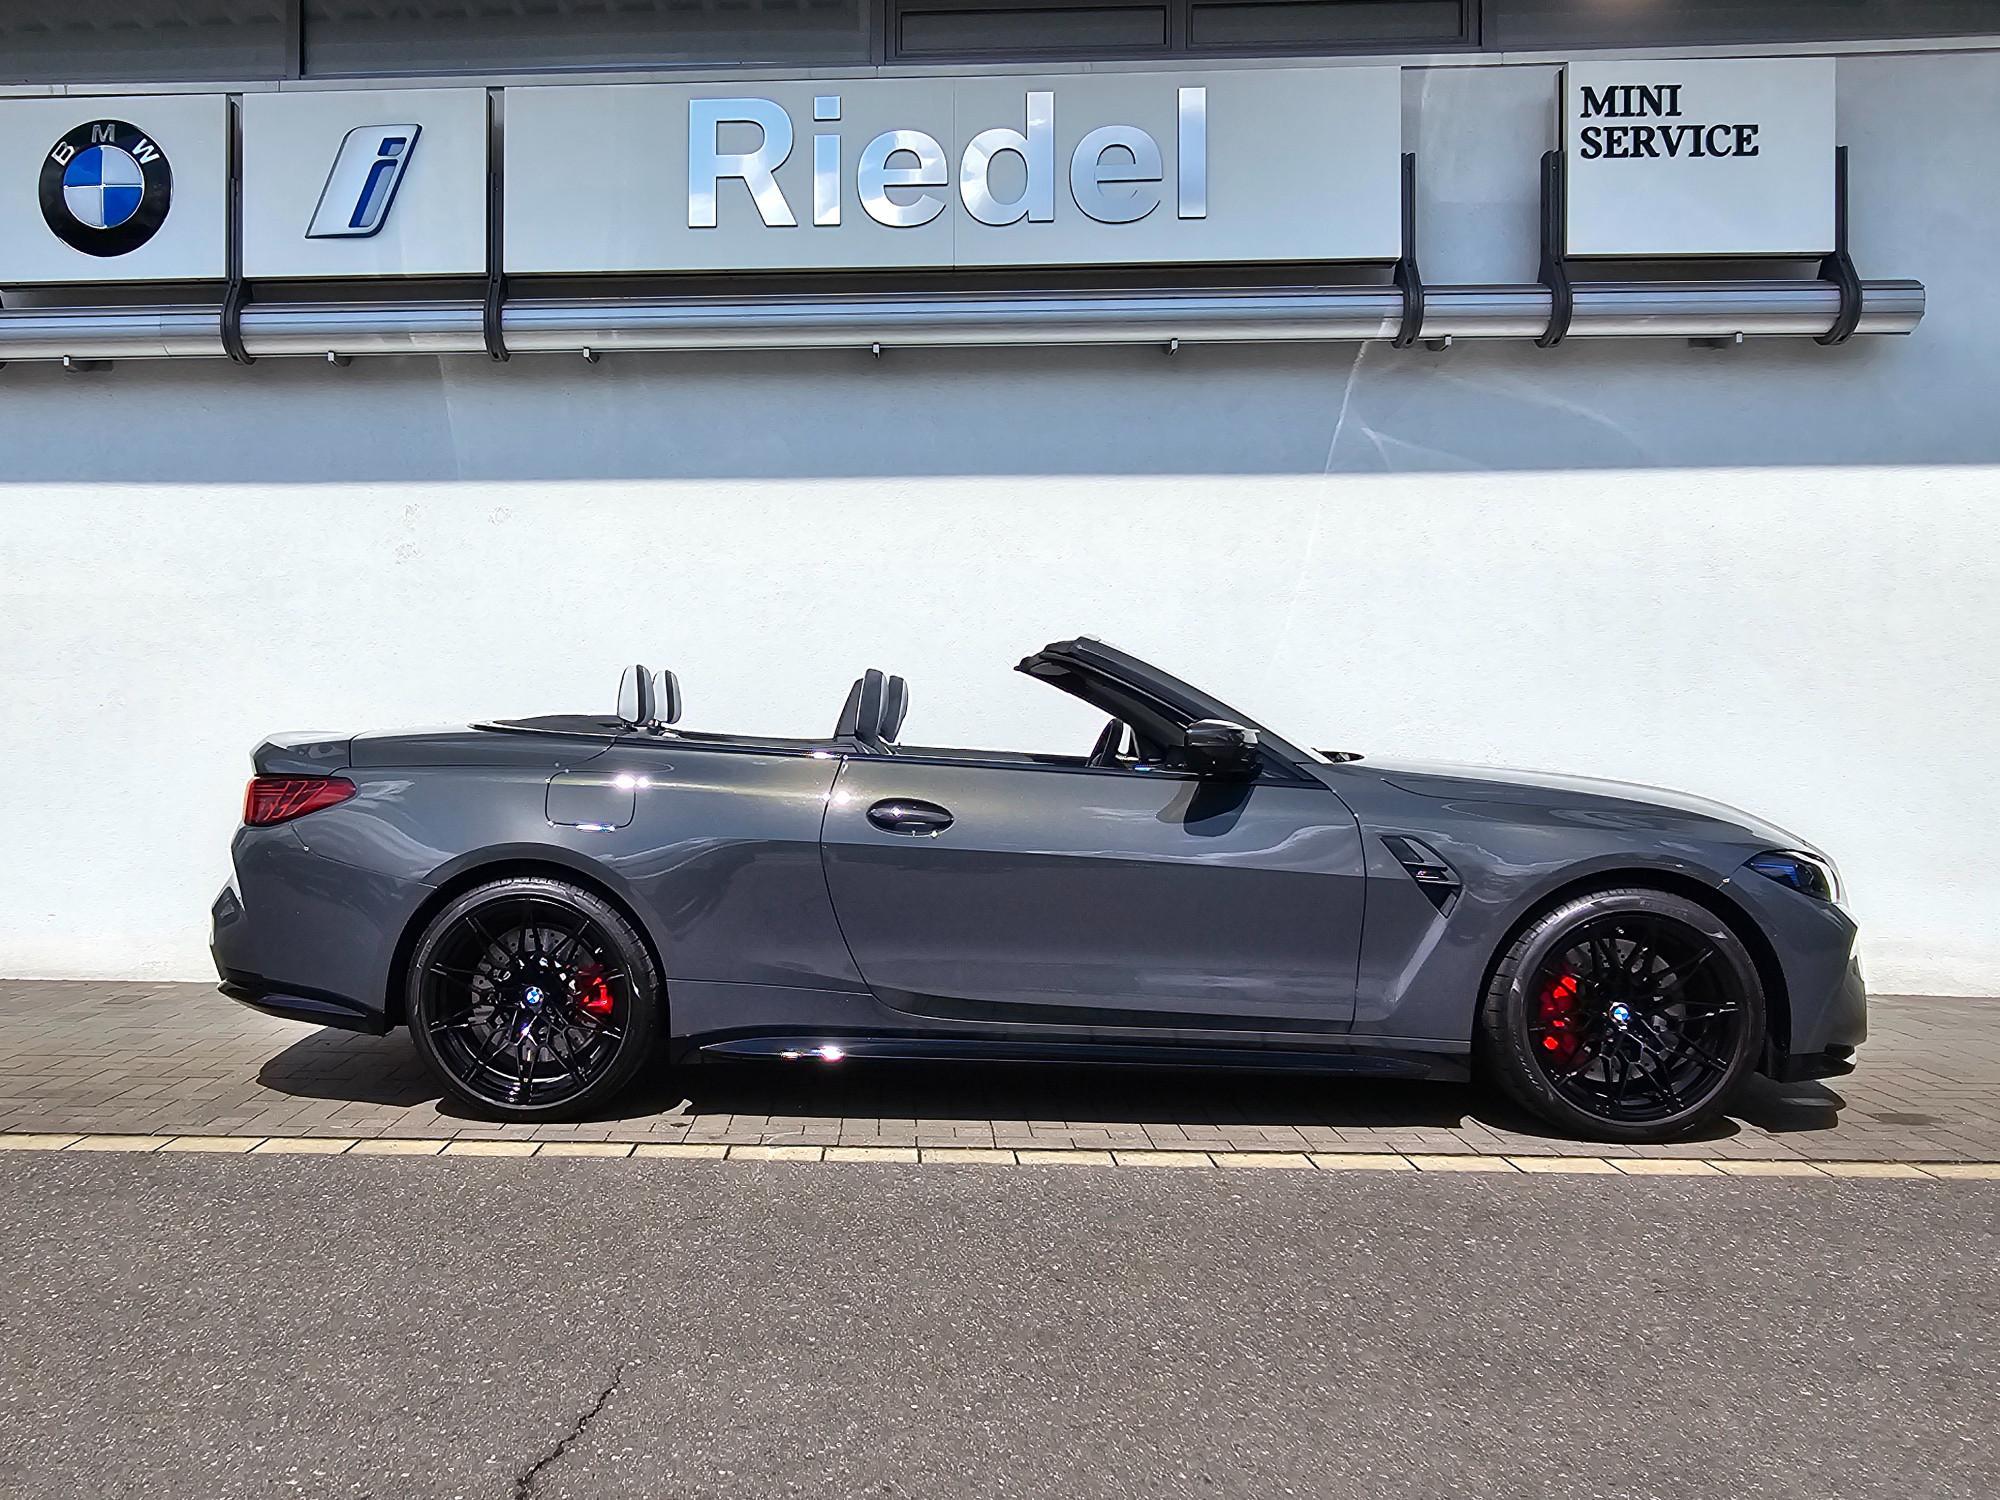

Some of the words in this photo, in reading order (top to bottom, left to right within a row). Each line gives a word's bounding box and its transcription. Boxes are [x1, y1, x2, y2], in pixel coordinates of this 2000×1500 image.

[1580, 84, 1682, 118] MINI
[51, 123, 160, 167] BMW
[688, 87, 1207, 228] Riedel
[1580, 124, 1759, 159] SERVICE
